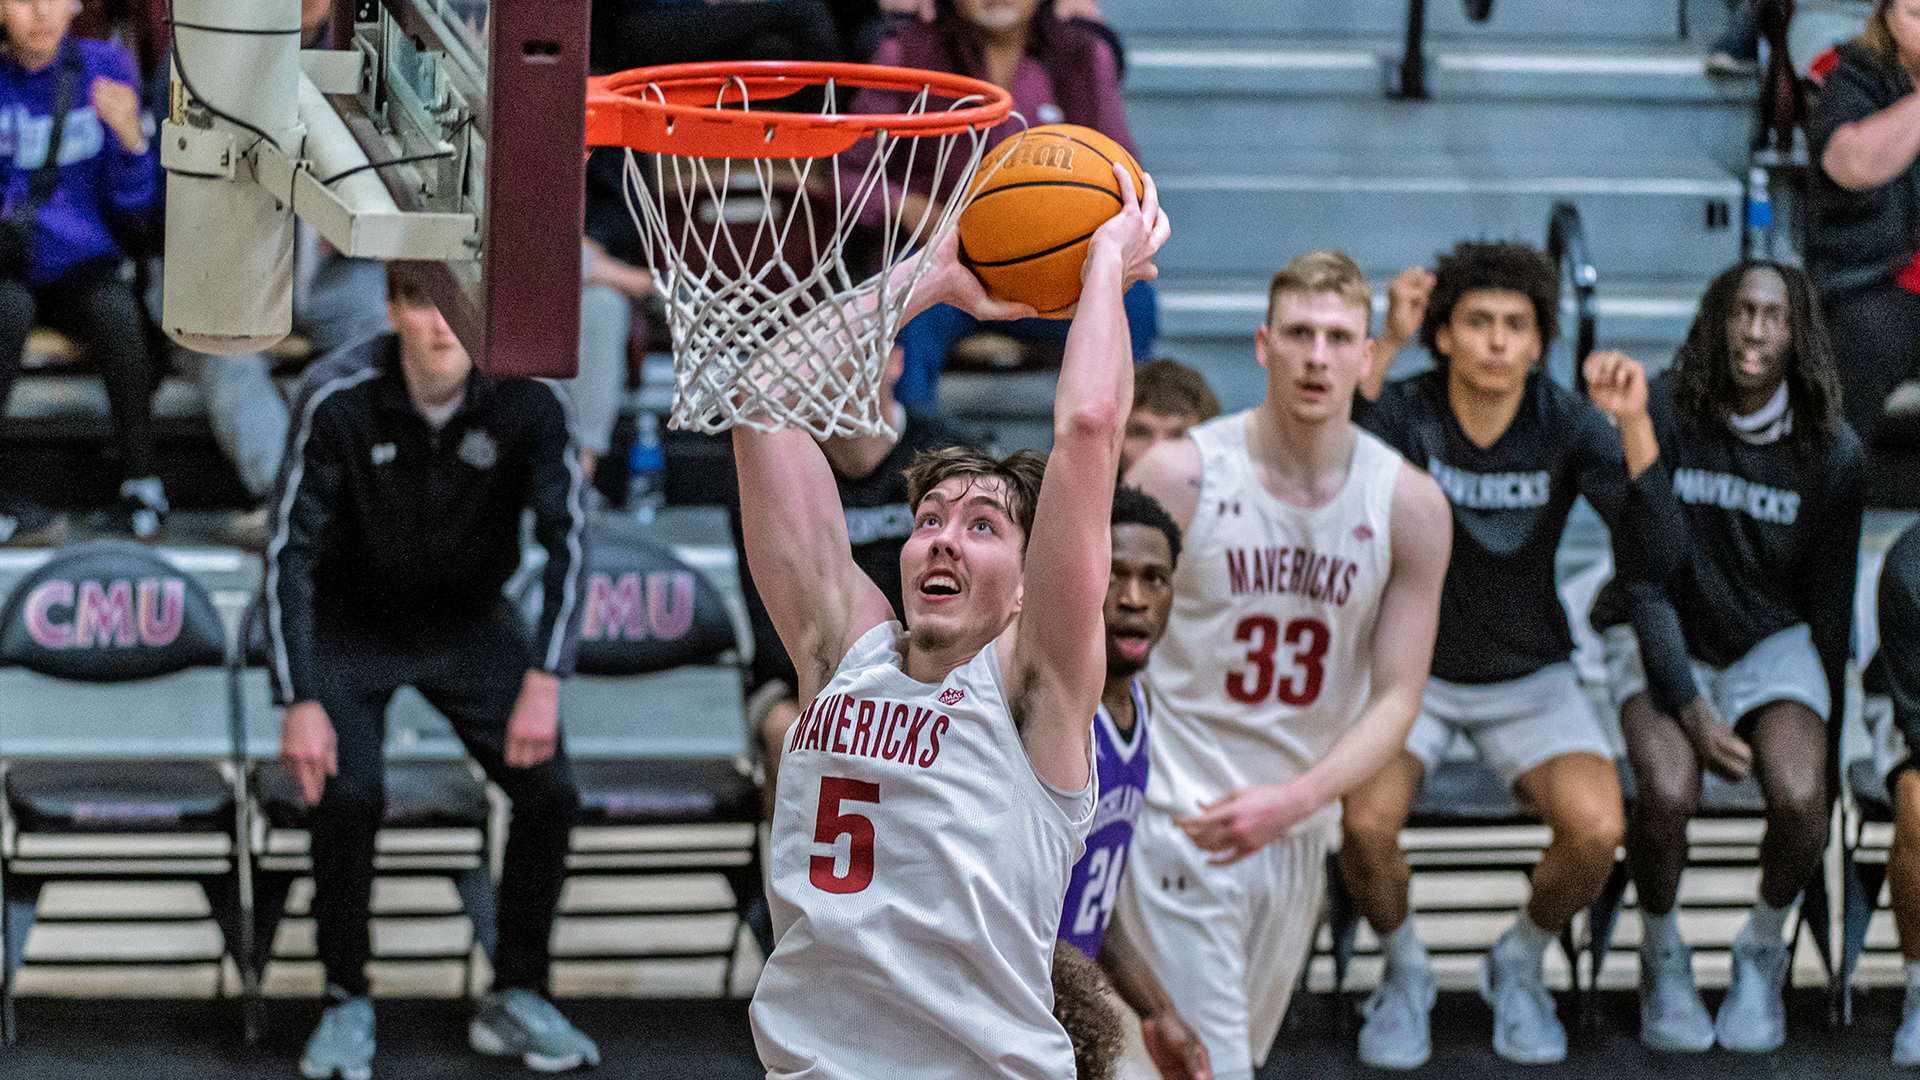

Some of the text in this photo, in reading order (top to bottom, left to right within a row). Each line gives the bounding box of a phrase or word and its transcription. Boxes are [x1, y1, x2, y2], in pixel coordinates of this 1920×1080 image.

[24, 579, 185, 648] CMU
[581, 571, 695, 640] MU
[1227, 548, 1358, 607] MAVERICKS
[1226, 615, 1330, 706] 33
[789, 694, 949, 769] MAVERICKS
[809, 775, 880, 894] 5
